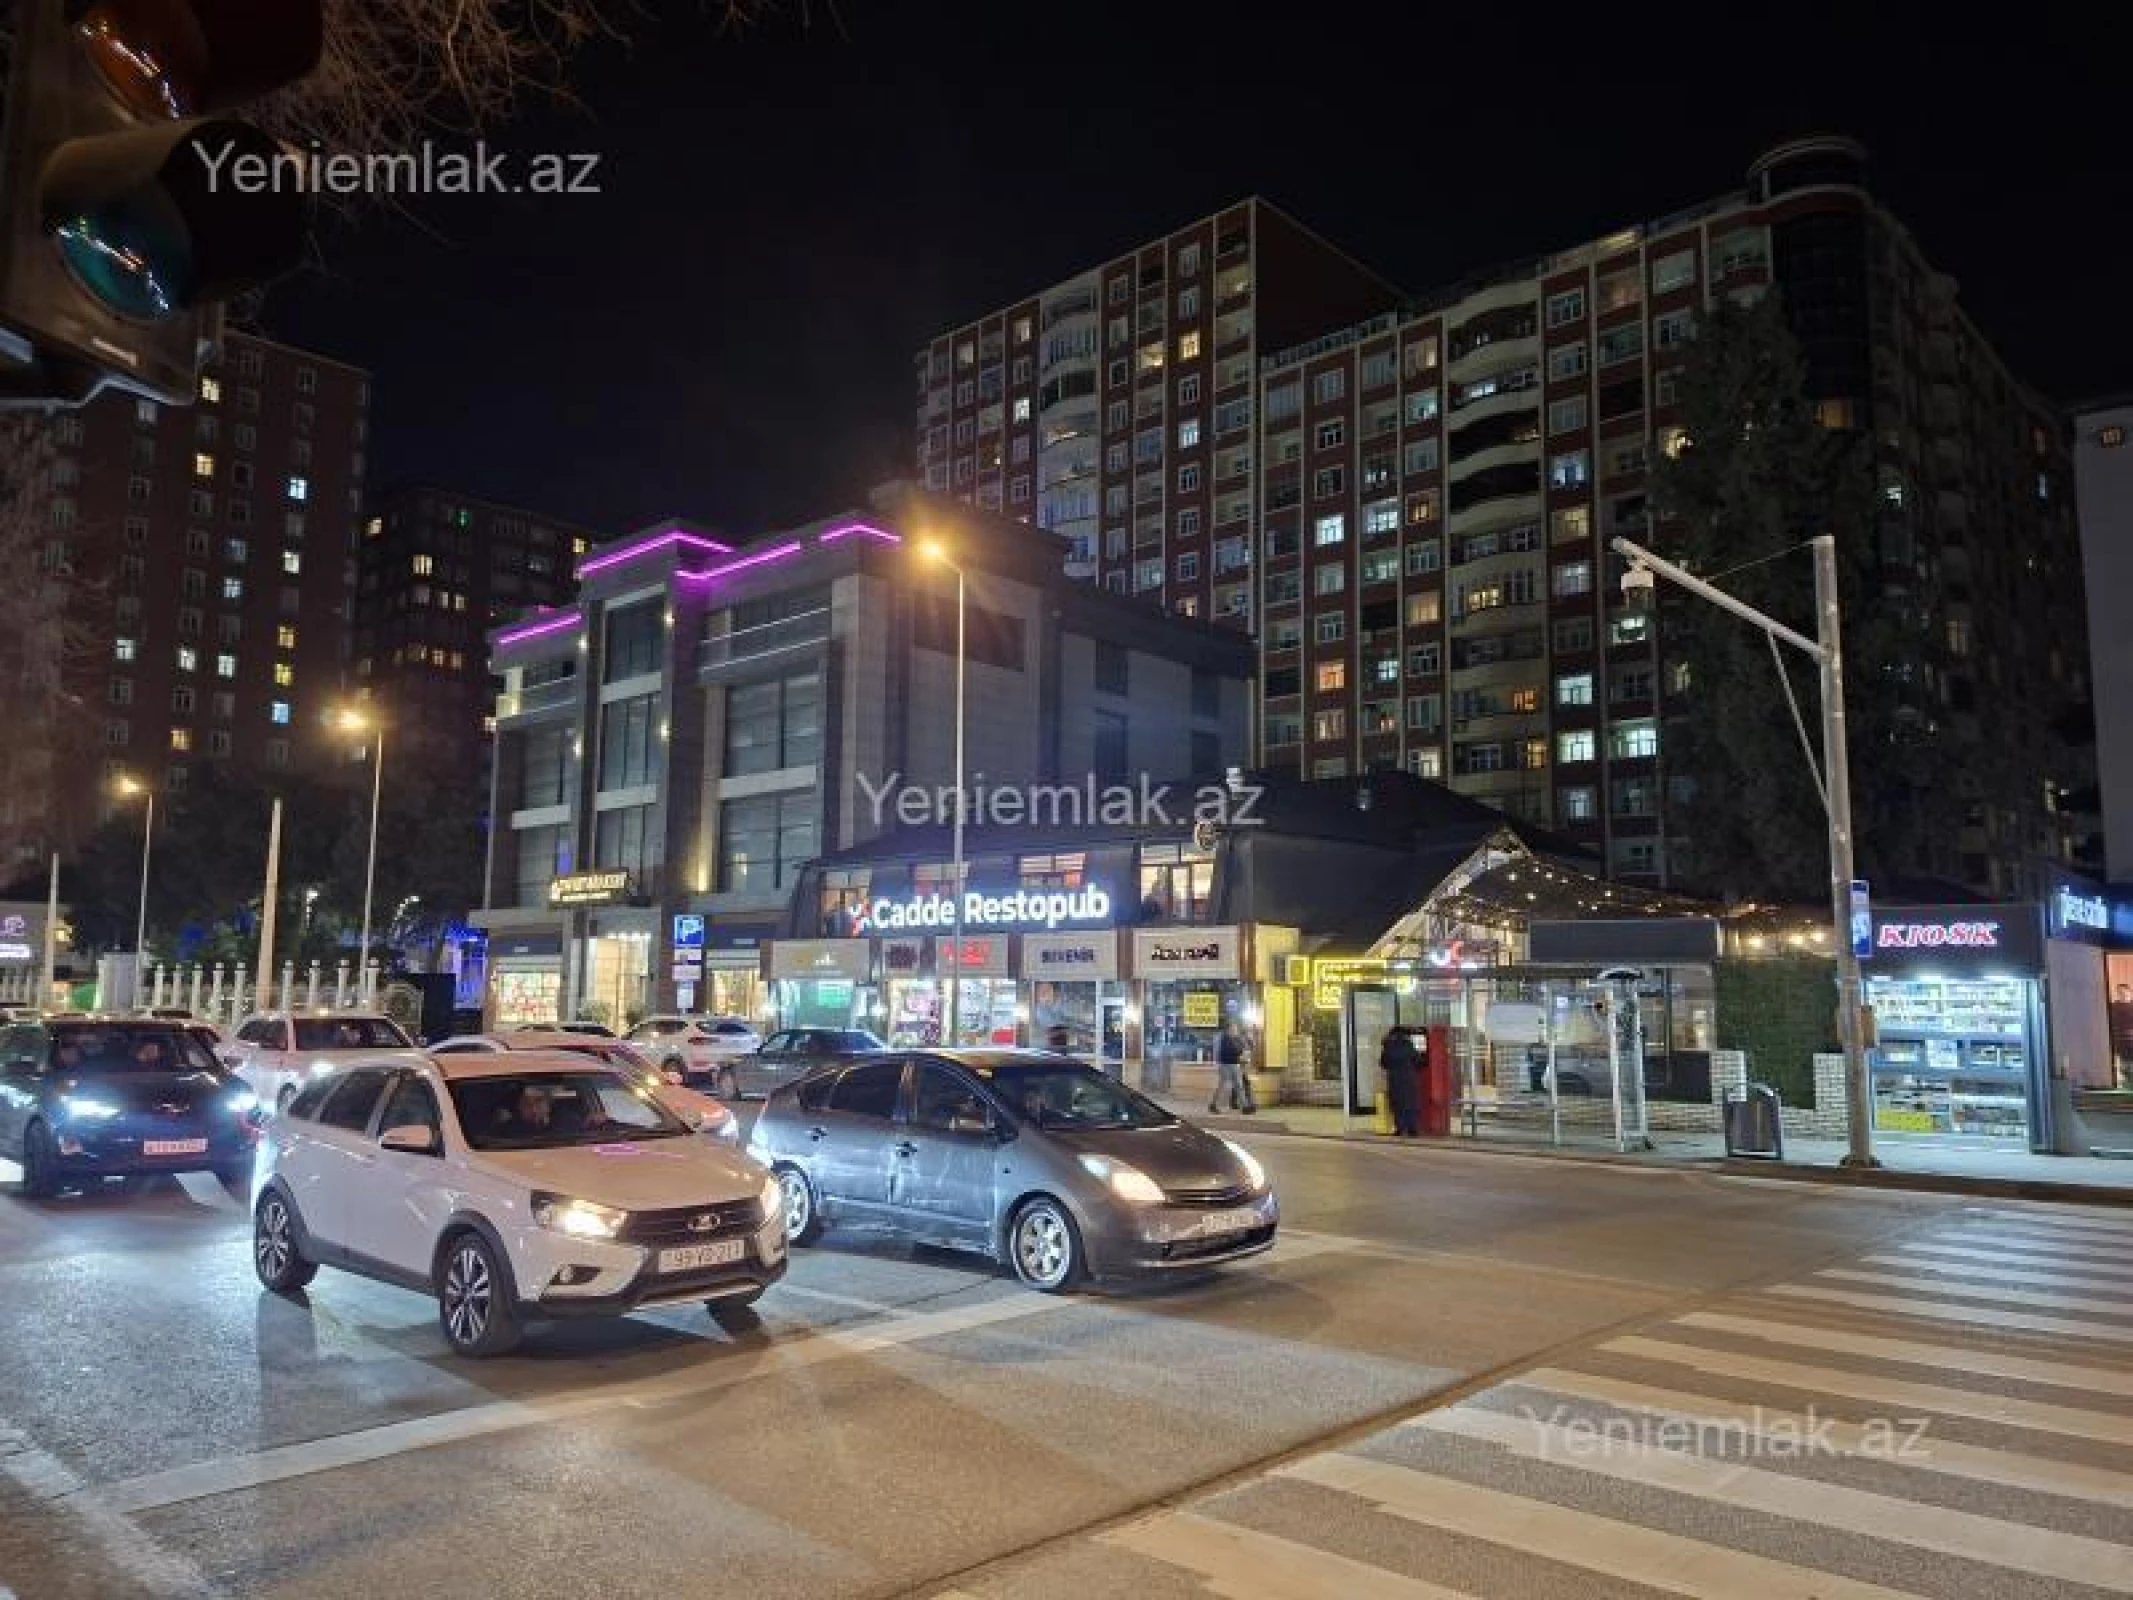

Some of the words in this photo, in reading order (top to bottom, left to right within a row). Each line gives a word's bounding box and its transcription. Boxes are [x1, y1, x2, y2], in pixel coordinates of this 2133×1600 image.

[872, 894, 956, 928] Cadde
[964, 883, 1110, 928] Restopub
[1877, 922, 1999, 948] KIOSK
